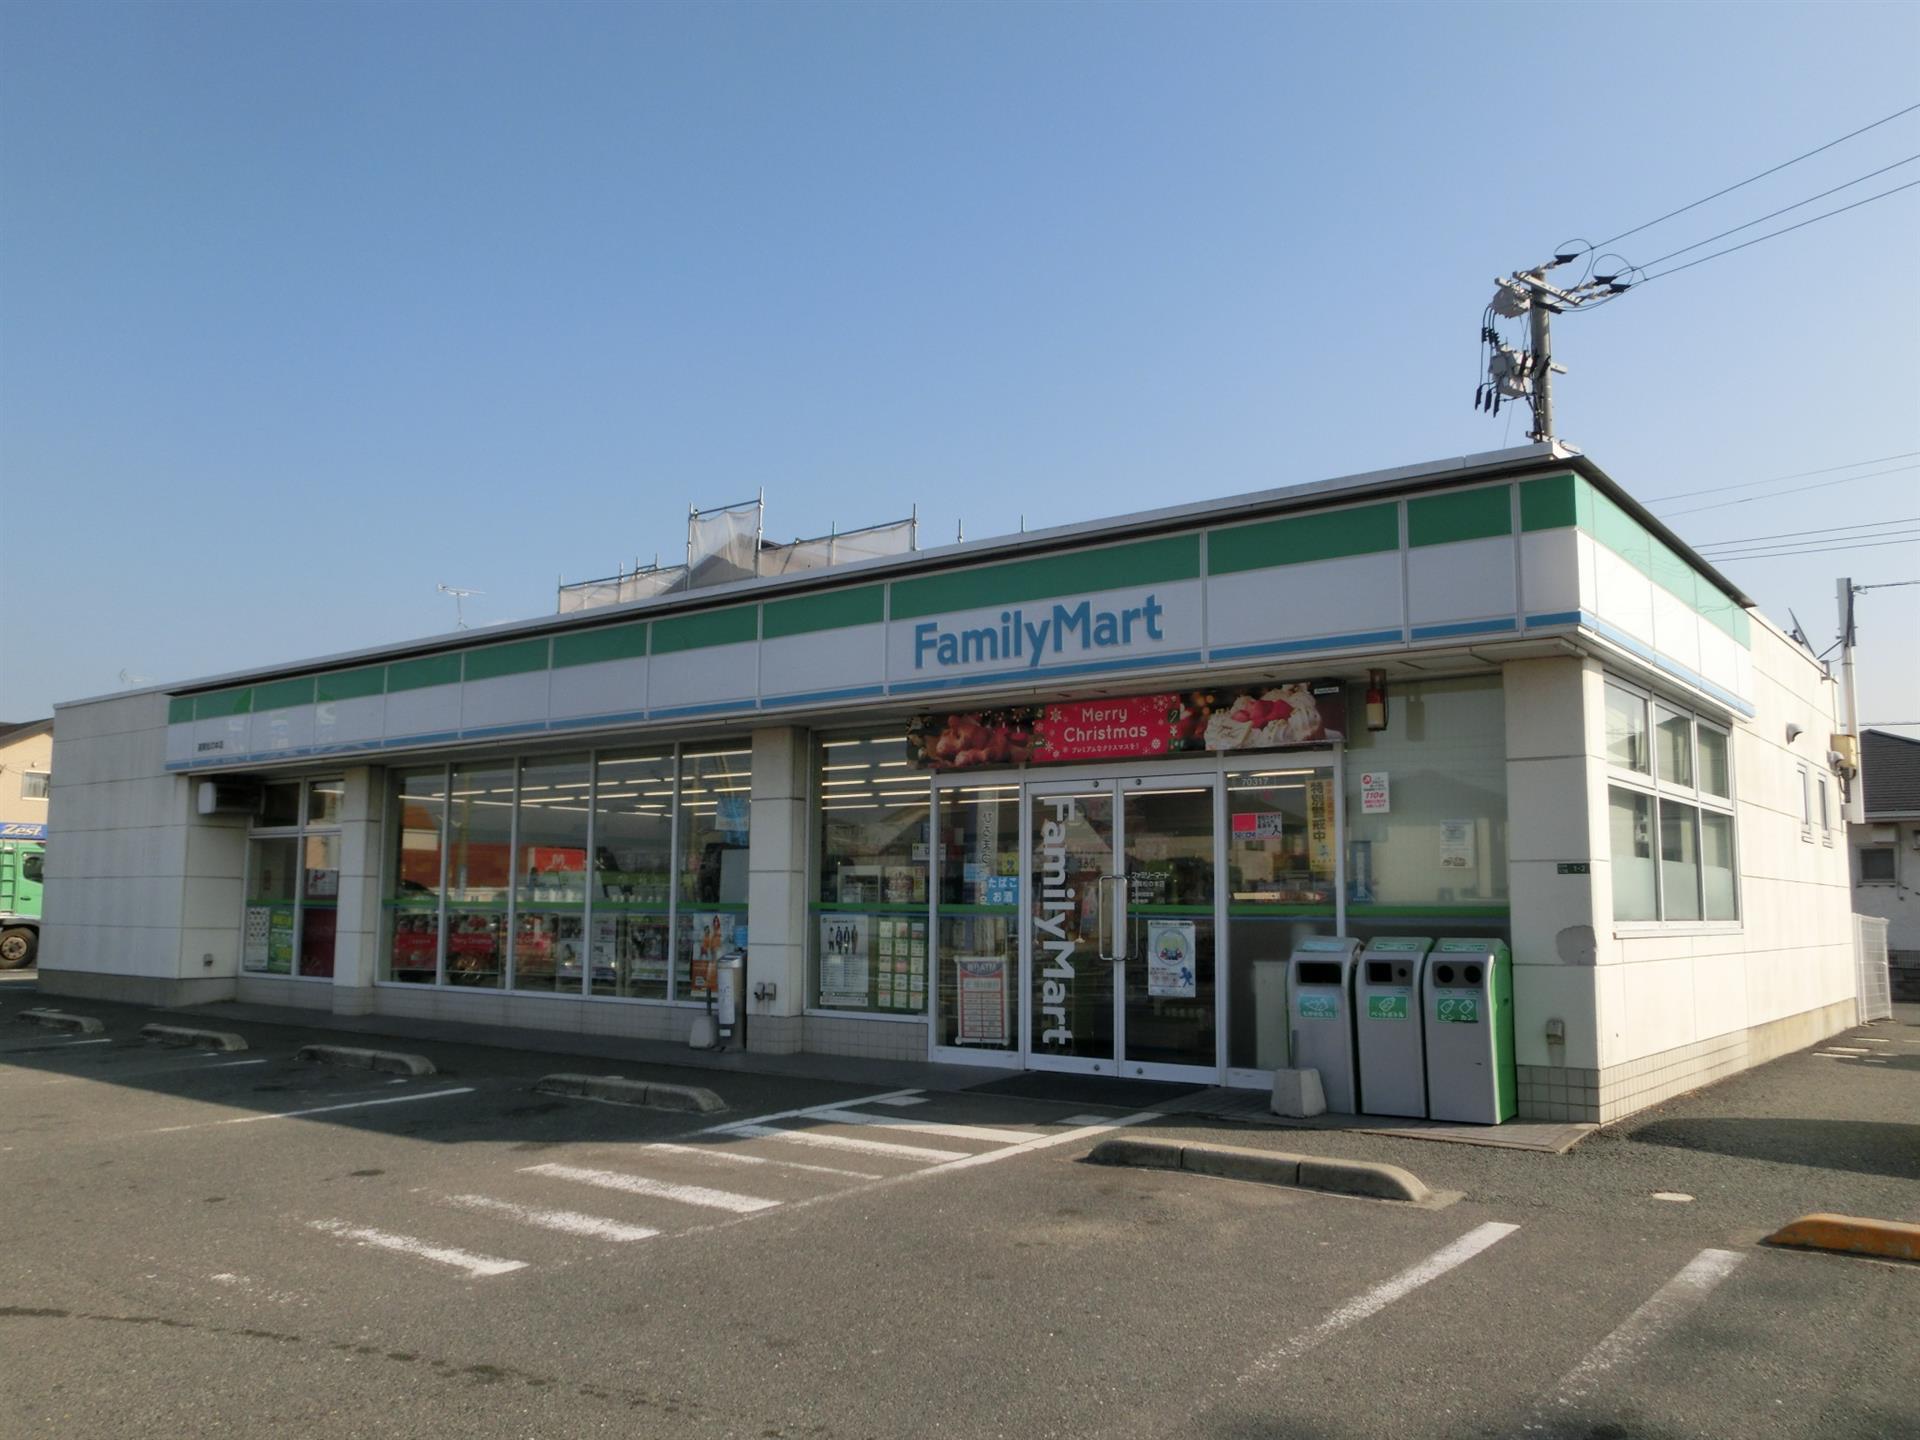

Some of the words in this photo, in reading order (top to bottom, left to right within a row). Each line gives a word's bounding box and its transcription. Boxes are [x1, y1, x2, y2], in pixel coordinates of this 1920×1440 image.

[914, 593, 1164, 671] FamilyMart
[1081, 707, 1128, 723] Merry
[1063, 724, 1149, 743] Christmas
[1241, 777, 1269, 786] 70317
[988, 877, 1018, 888] たばこ
[992, 890, 1014, 903] お酒
[1033, 796, 1077, 1046] FamilyMart
